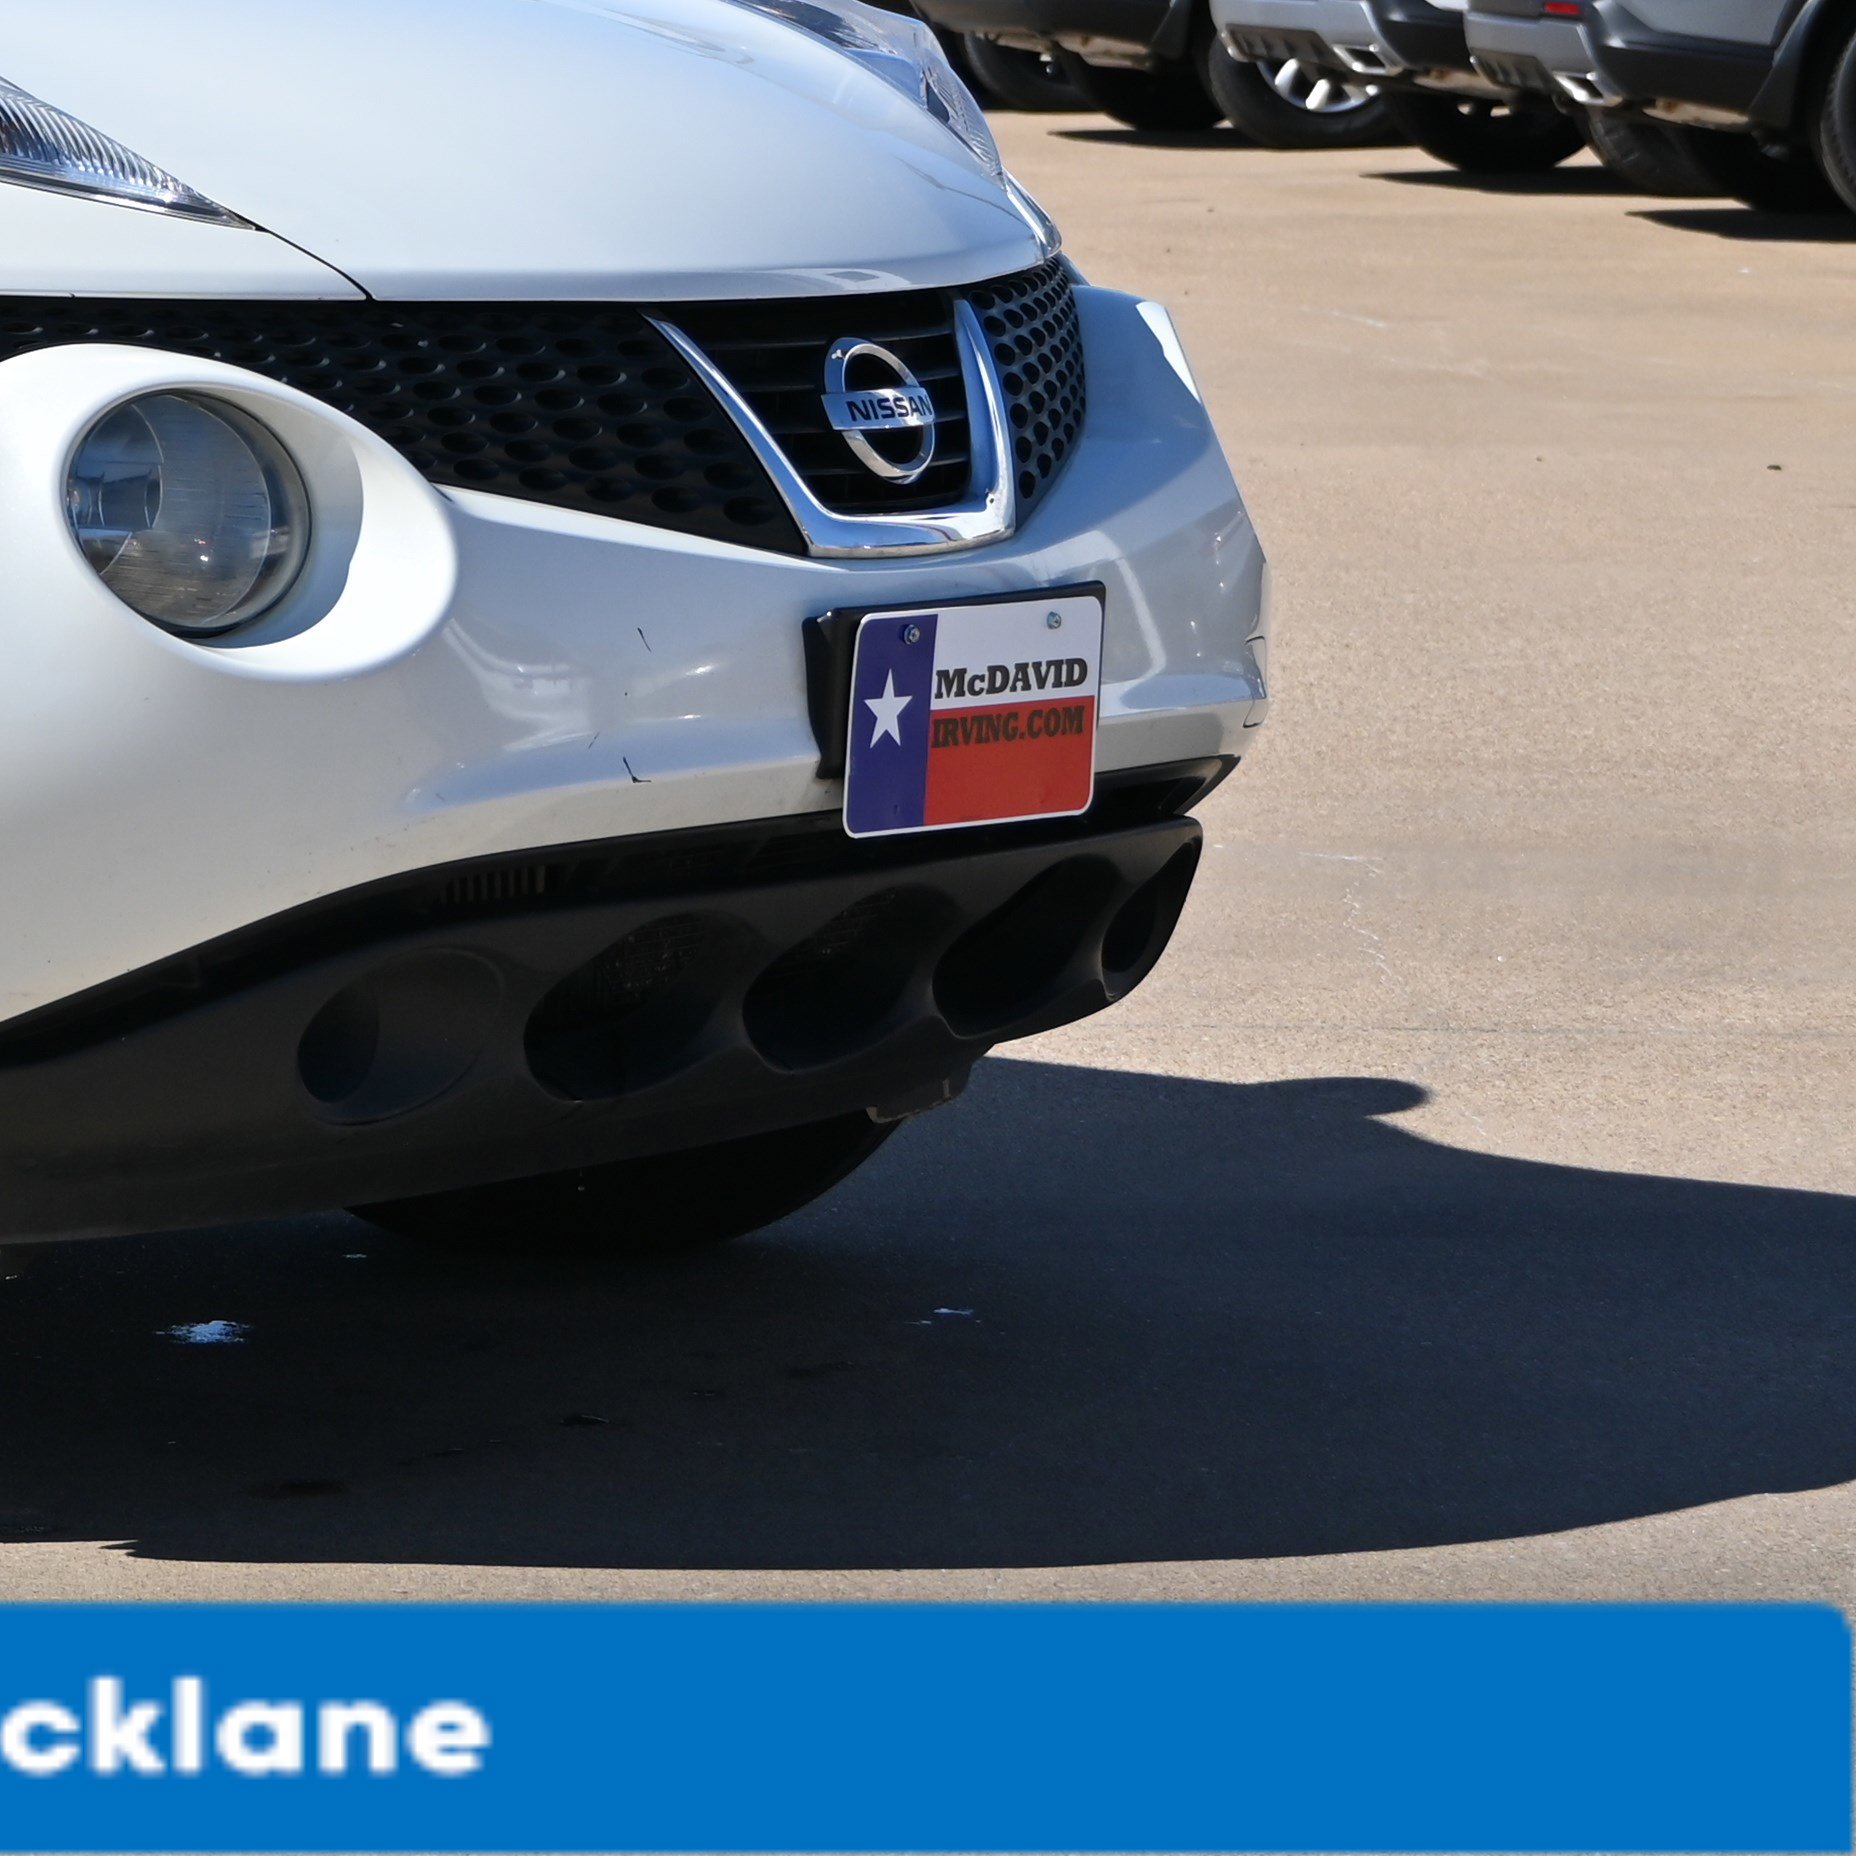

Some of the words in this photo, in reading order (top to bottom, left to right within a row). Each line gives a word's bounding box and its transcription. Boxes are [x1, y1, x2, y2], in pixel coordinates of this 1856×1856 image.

[845, 393, 934, 423] NISSAN
[933, 657, 1089, 701] McDAVID
[930, 704, 1086, 749] IRVING.COM
